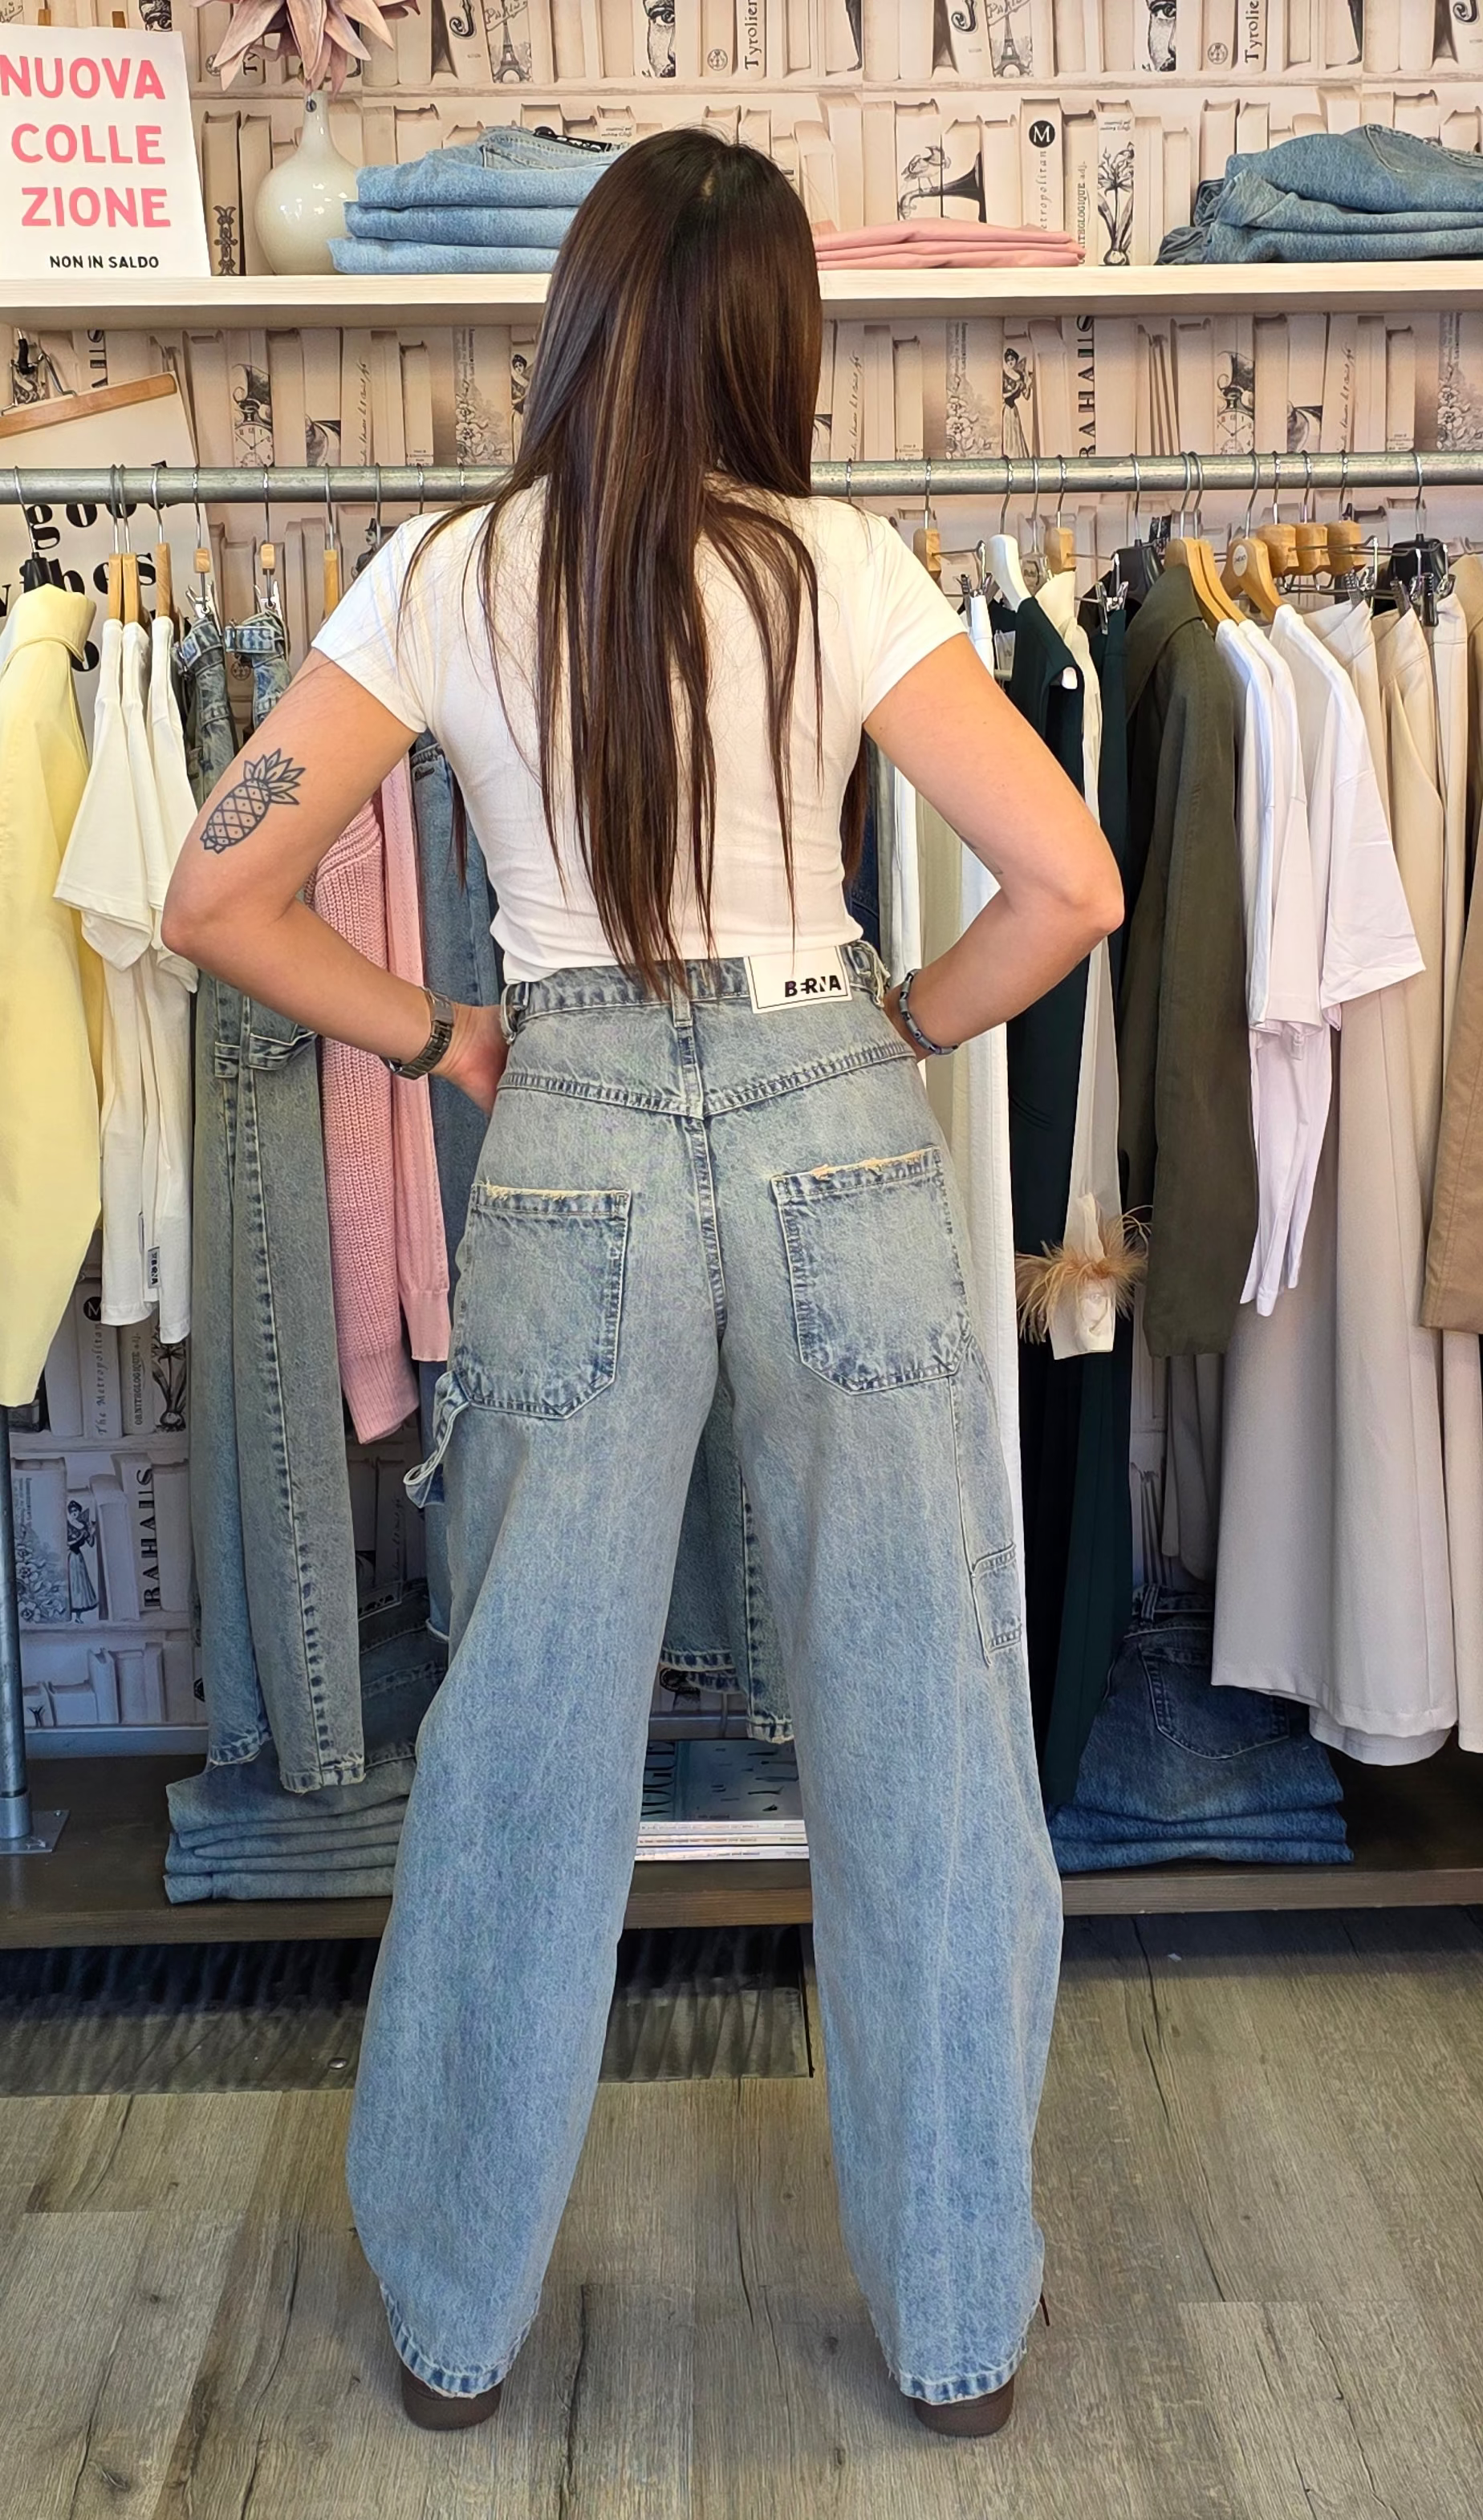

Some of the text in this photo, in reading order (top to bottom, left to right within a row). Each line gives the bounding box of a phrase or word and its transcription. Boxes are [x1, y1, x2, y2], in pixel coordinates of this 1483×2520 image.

[0, 54, 166, 100] NUOVA
[10, 123, 166, 165] COLLE
[21, 186, 172, 228] ZIONE
[49, 255, 160, 269] NON IN SALDO
[91, 1323, 109, 1435] The Metropolitan
